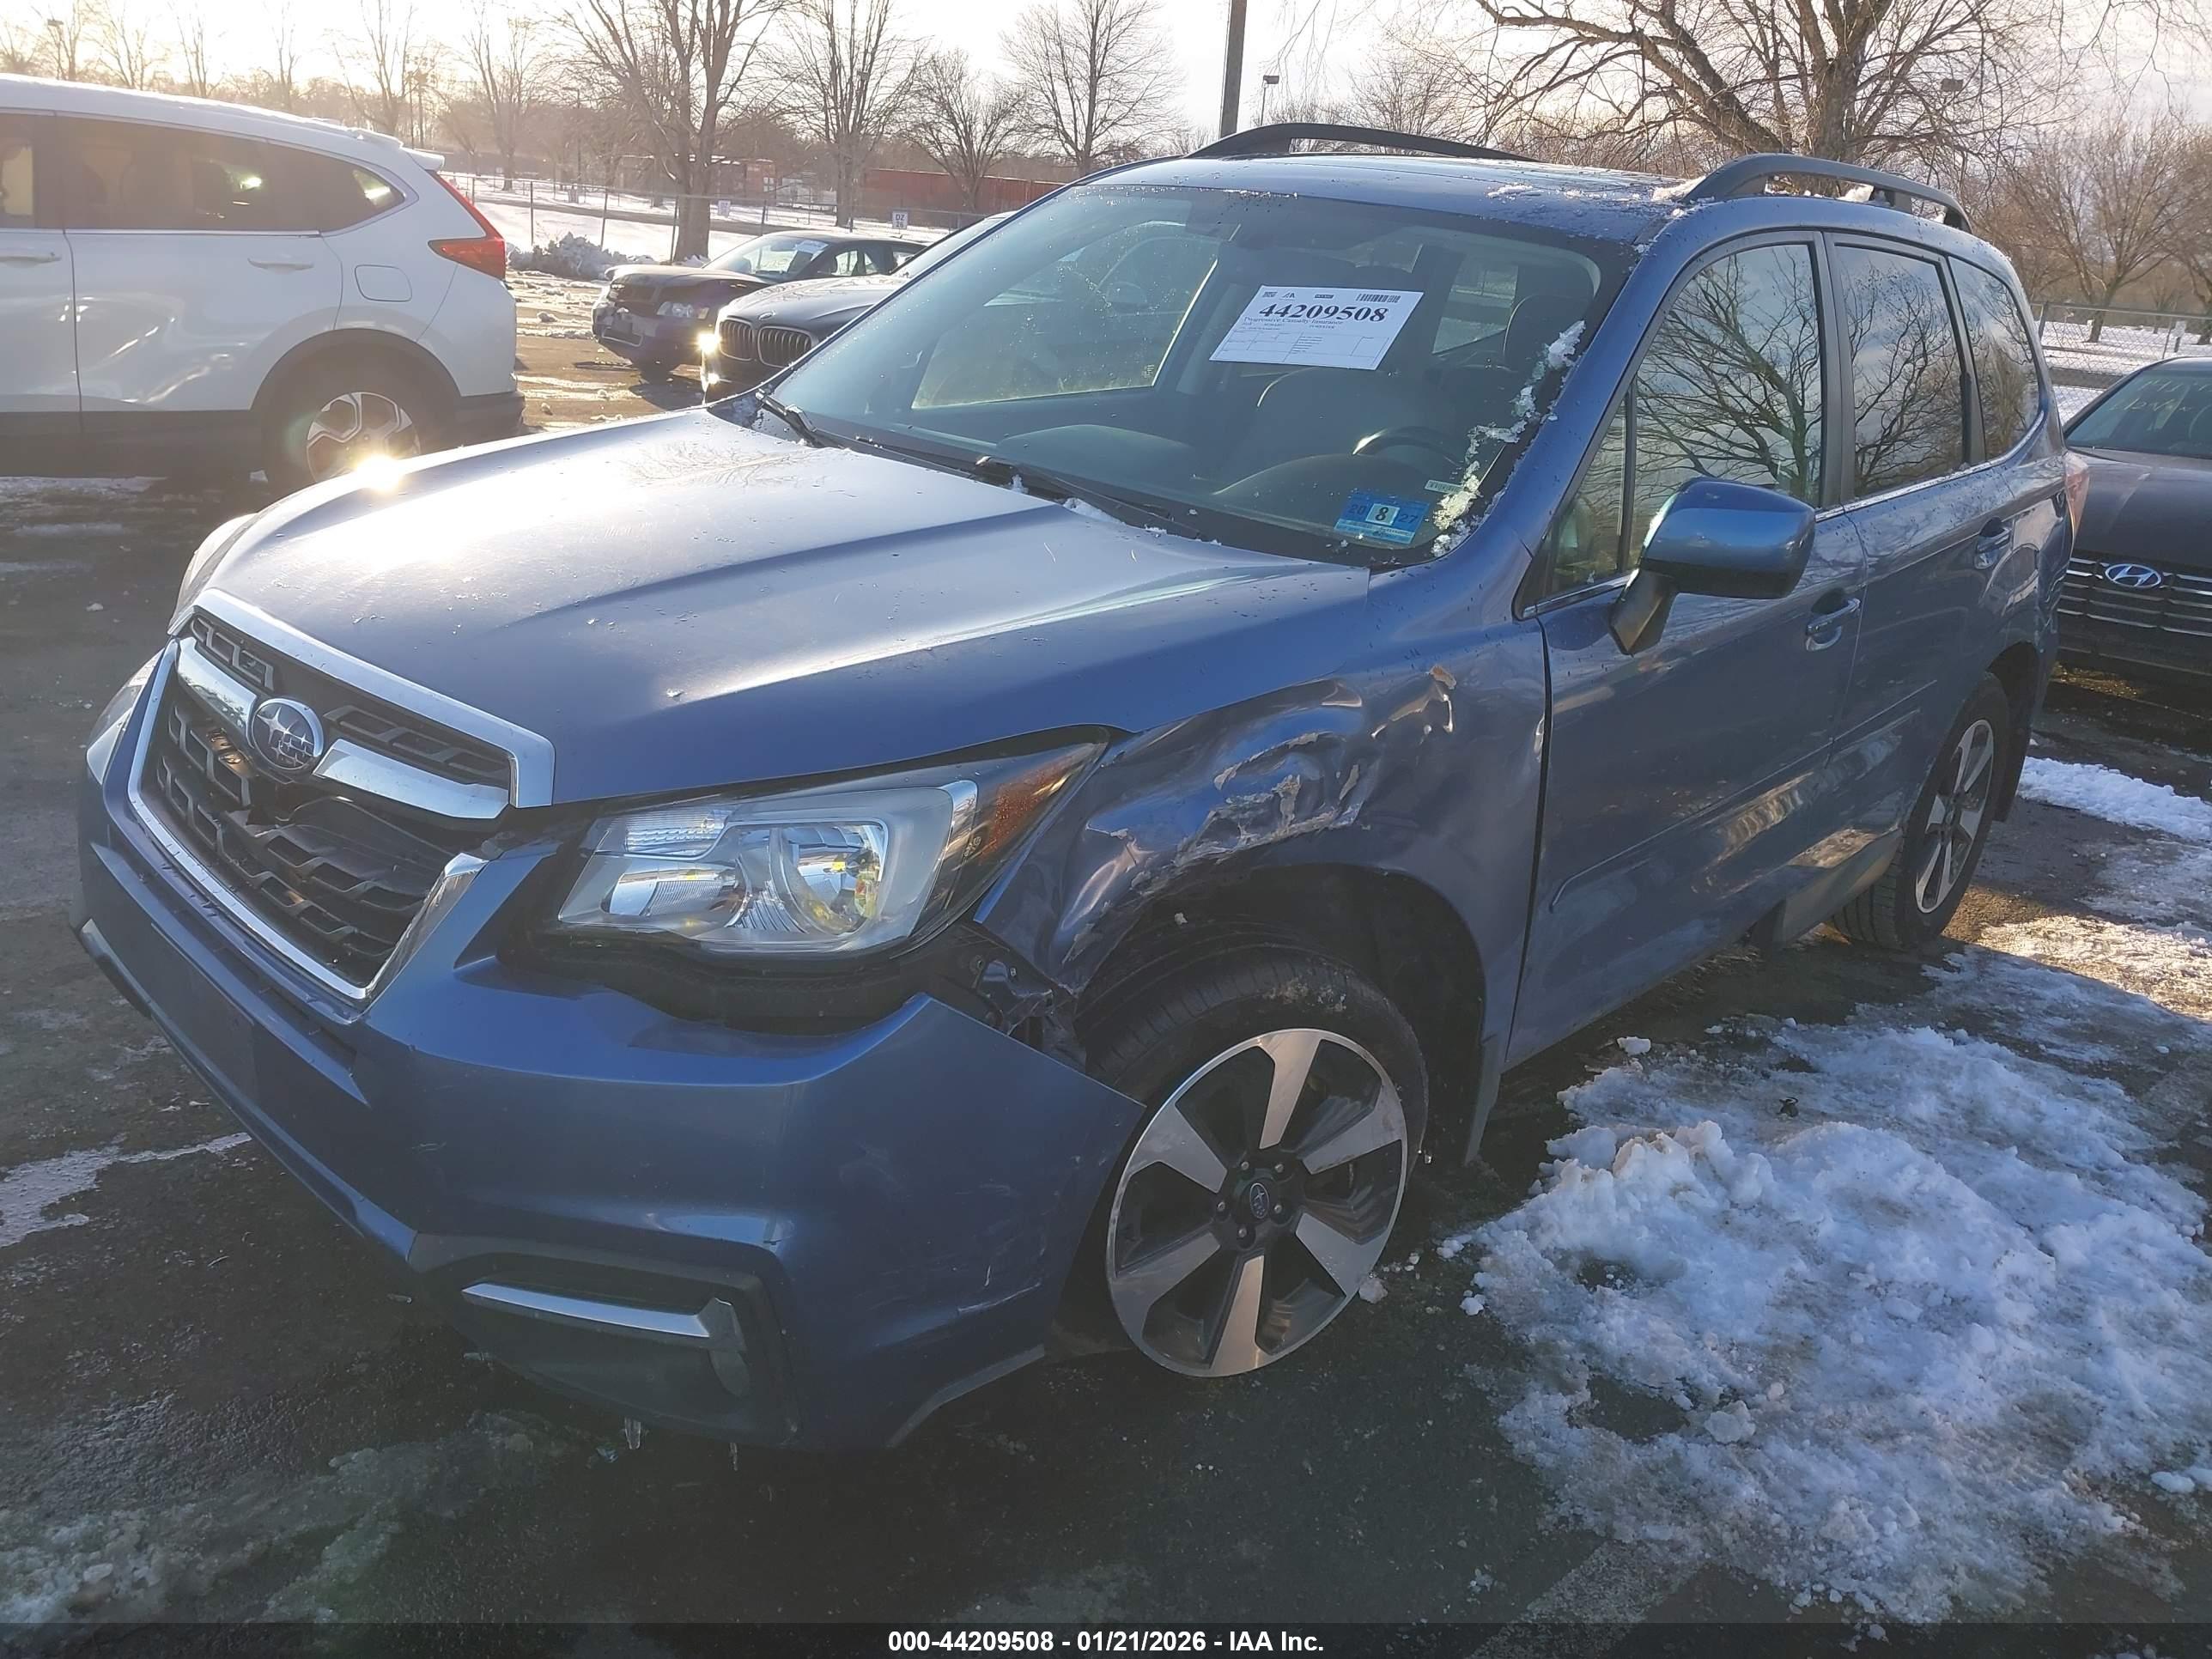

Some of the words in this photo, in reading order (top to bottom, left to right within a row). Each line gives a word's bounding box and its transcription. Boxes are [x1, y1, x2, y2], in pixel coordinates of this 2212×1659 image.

[1259, 303, 1389, 323] 44209508
[1375, 507, 1389, 521] 8
[1399, 514, 1418, 524] 27
